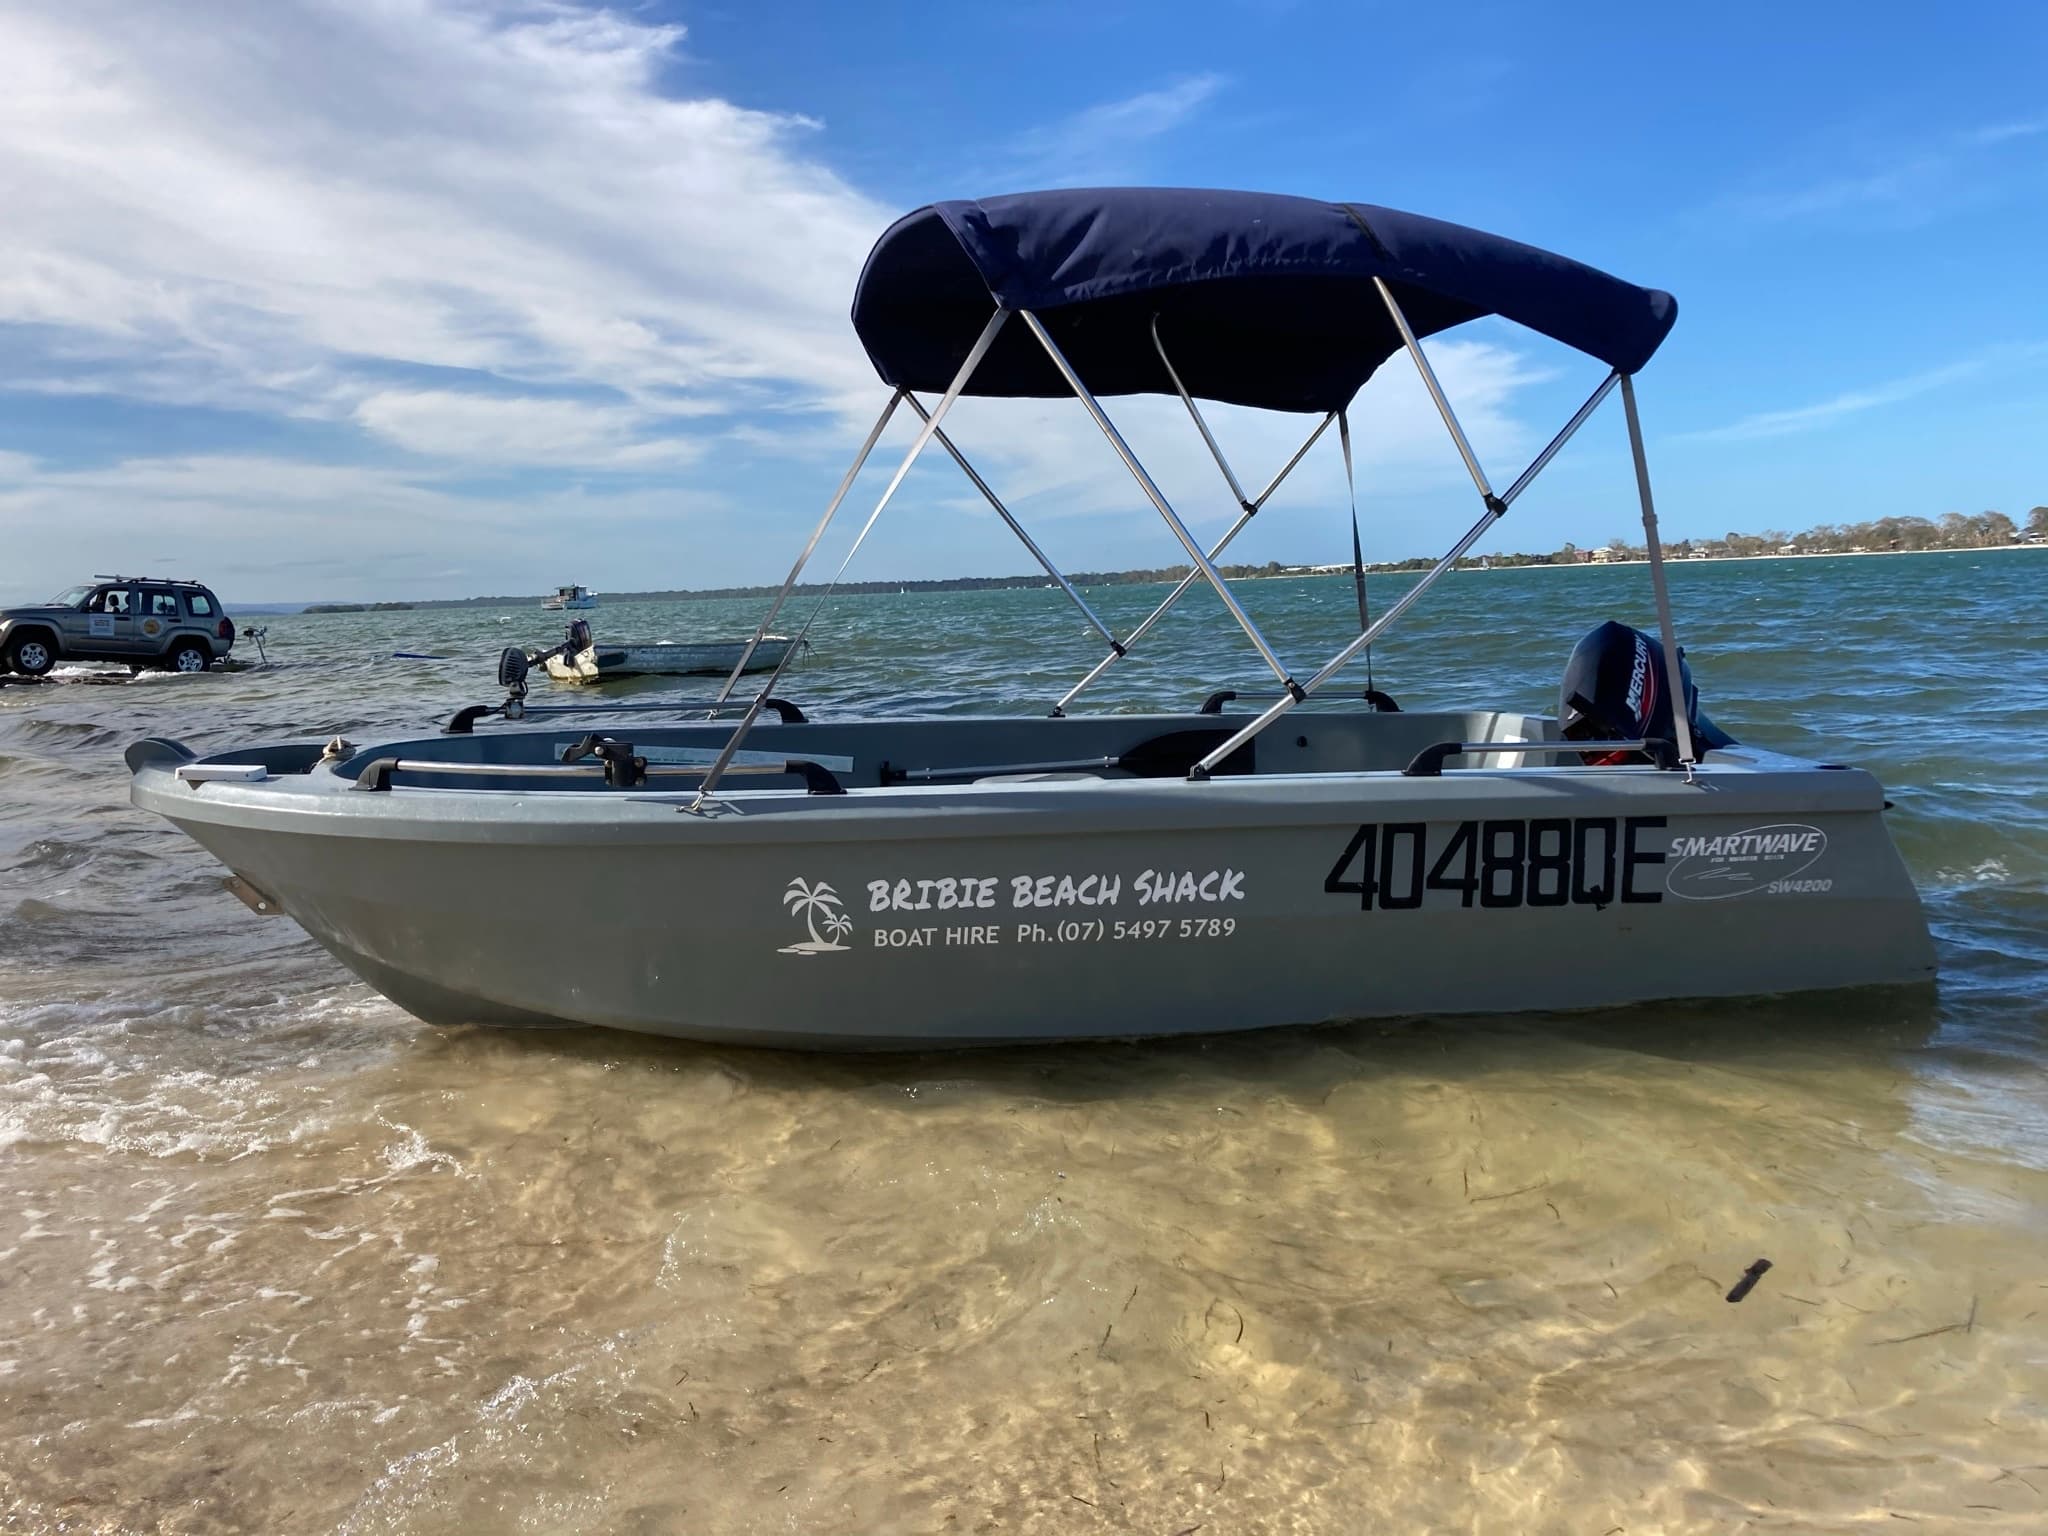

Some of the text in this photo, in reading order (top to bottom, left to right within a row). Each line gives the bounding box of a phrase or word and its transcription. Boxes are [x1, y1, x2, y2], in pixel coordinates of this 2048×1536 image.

[1625, 633, 1648, 714] MERCURY
[1668, 833, 1820, 857] SMARTWAVE
[1324, 816, 1667, 911] 40488QE
[867, 868, 1246, 912] BRIBIE BEACH SHACK
[1768, 879, 1832, 894] SW4200
[874, 927, 937, 947] BOAT
[945, 926, 998, 946] HIRE
[1113, 920, 1169, 940] 5497
[1179, 918, 1236, 938] 5789
